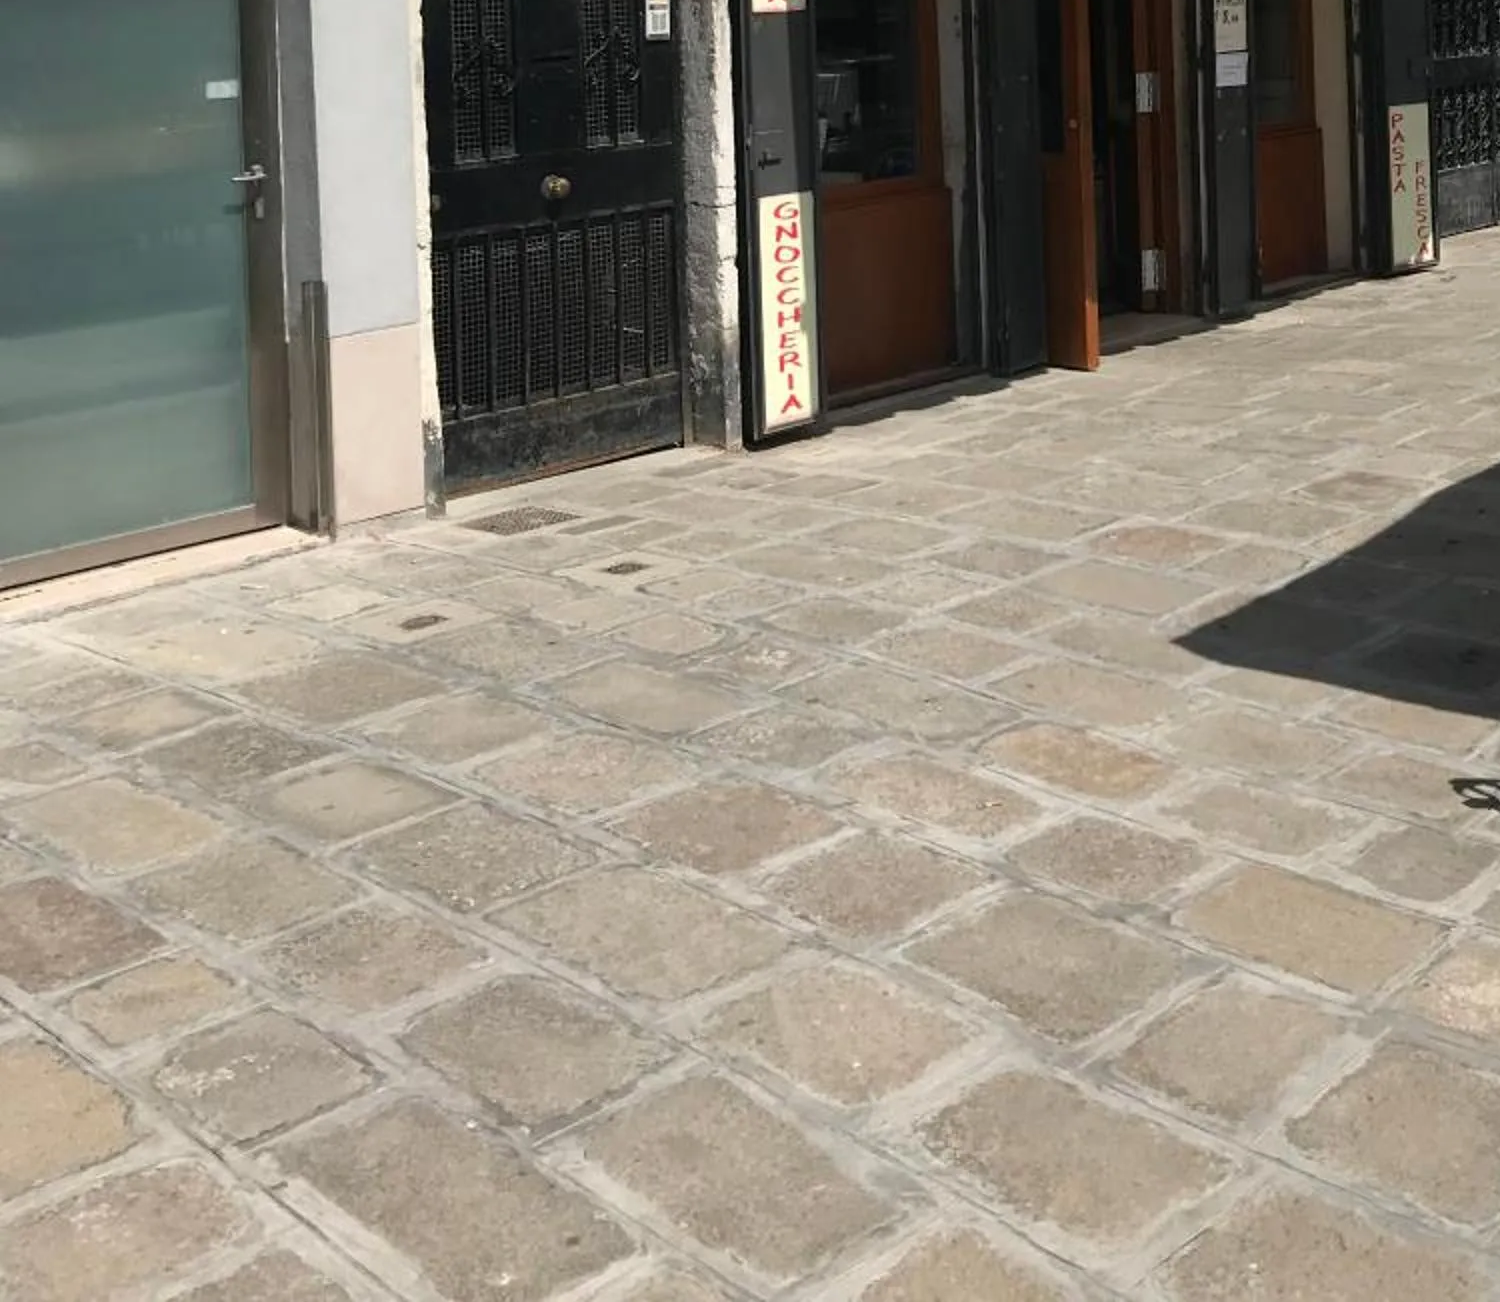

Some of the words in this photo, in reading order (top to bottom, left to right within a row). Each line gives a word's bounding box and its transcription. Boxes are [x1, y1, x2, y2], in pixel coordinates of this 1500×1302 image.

[1391, 113, 1406, 194] PASTA
[1415, 159, 1430, 261] FRESCA
[773, 201, 803, 414] GNOCCHERIA
